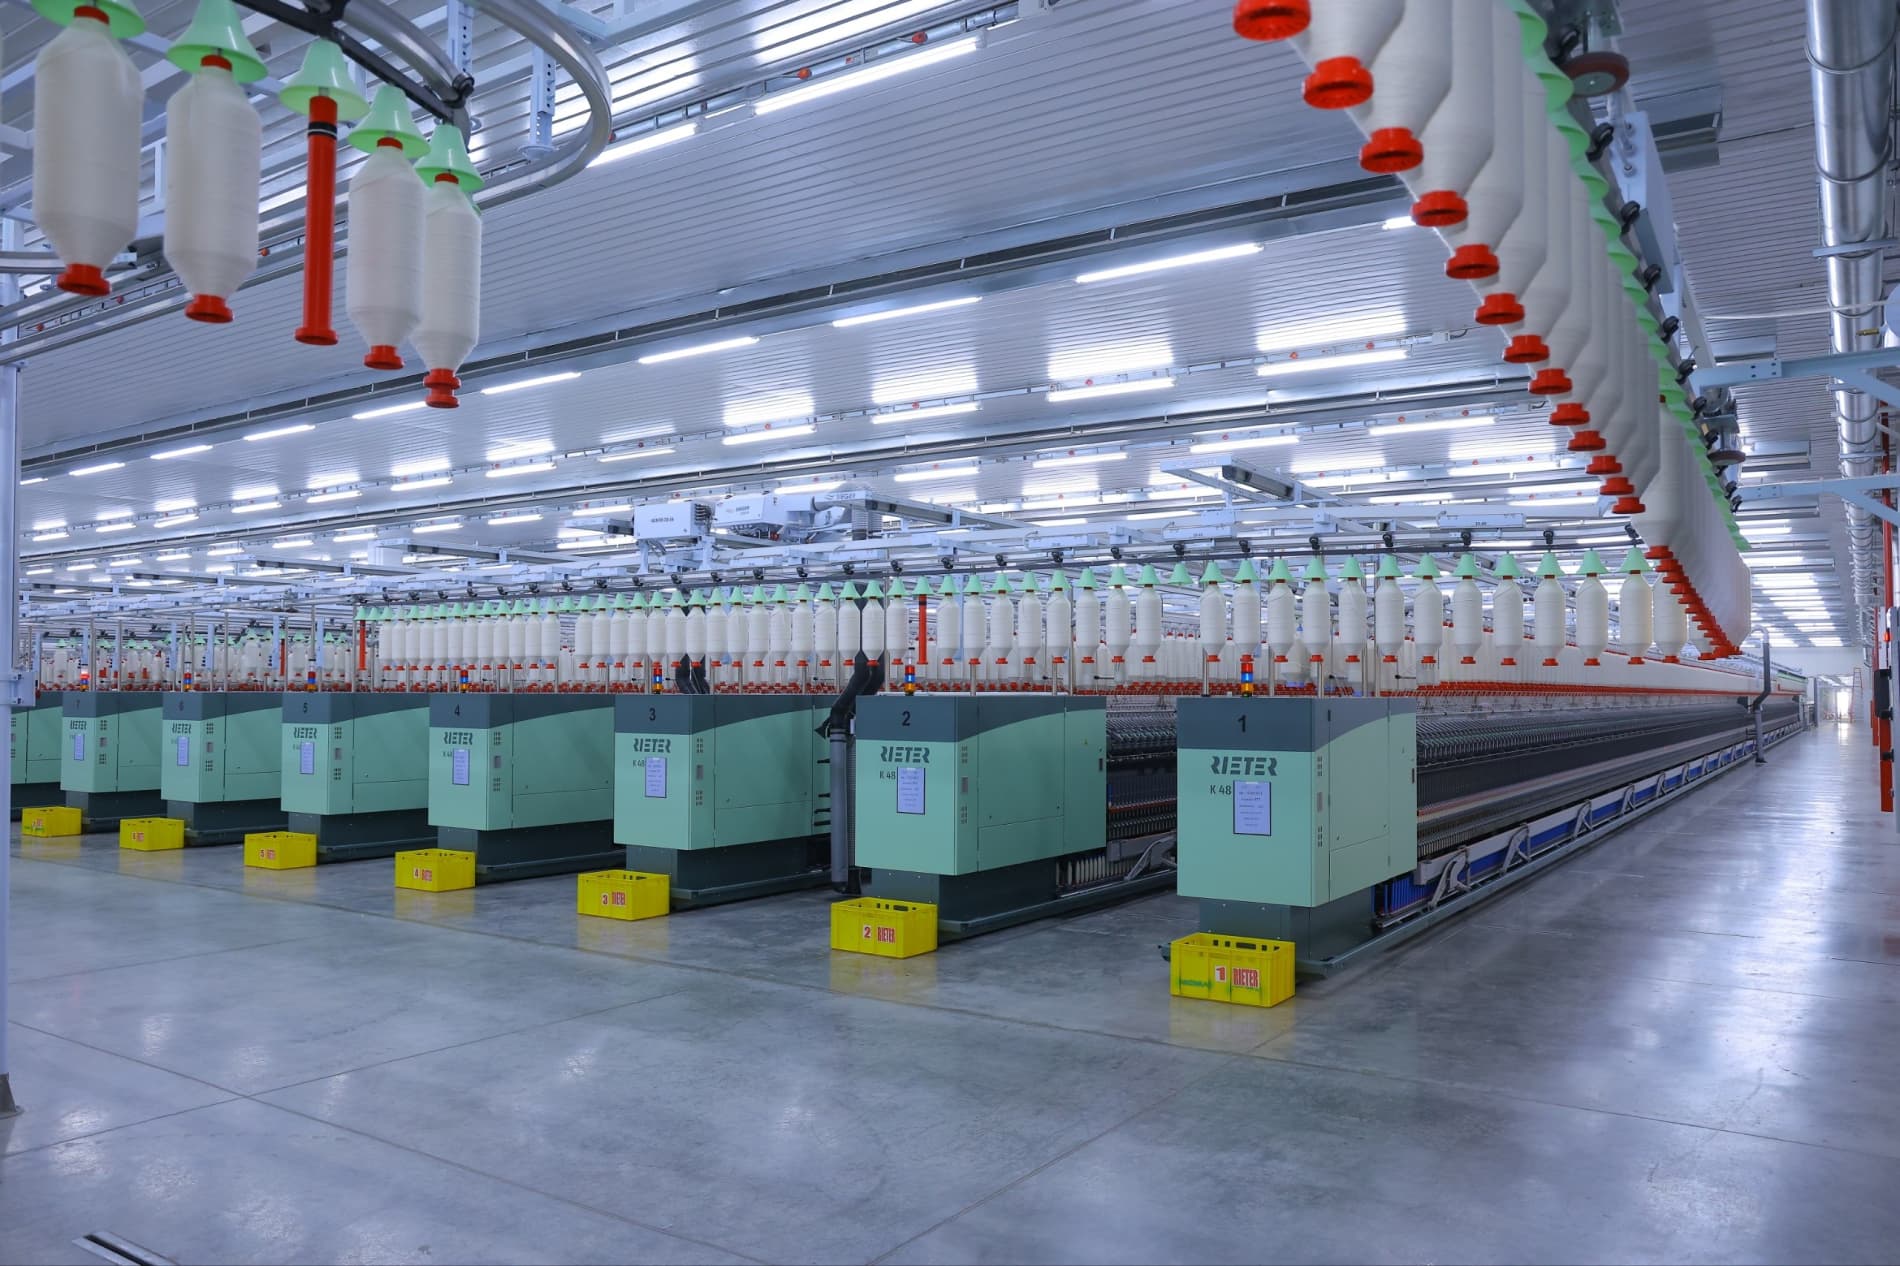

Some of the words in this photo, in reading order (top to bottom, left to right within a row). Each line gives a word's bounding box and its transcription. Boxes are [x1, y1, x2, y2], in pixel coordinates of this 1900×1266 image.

[303, 702, 309, 715] 5
[454, 703, 461, 717] 4
[648, 707, 657, 722] 3
[901, 710, 911, 727] 2
[1237, 714, 1247, 733] 1
[171, 722, 192, 735] RIETER
[293, 727, 318, 740] RIETER
[443, 731, 474, 746] RIETER
[633, 738, 672, 754] RIETER
[880, 746, 930, 764] RIETER
[1210, 755, 1279, 777] RIETER
[879, 771, 885, 780] K
[886, 771, 897, 780] 48
[1209, 785, 1217, 796] K
[1218, 785, 1233, 796] 48
[864, 926, 872, 939] 2
[1216, 966, 1226, 981] 1
[1232, 967, 1260, 989] RIETER
